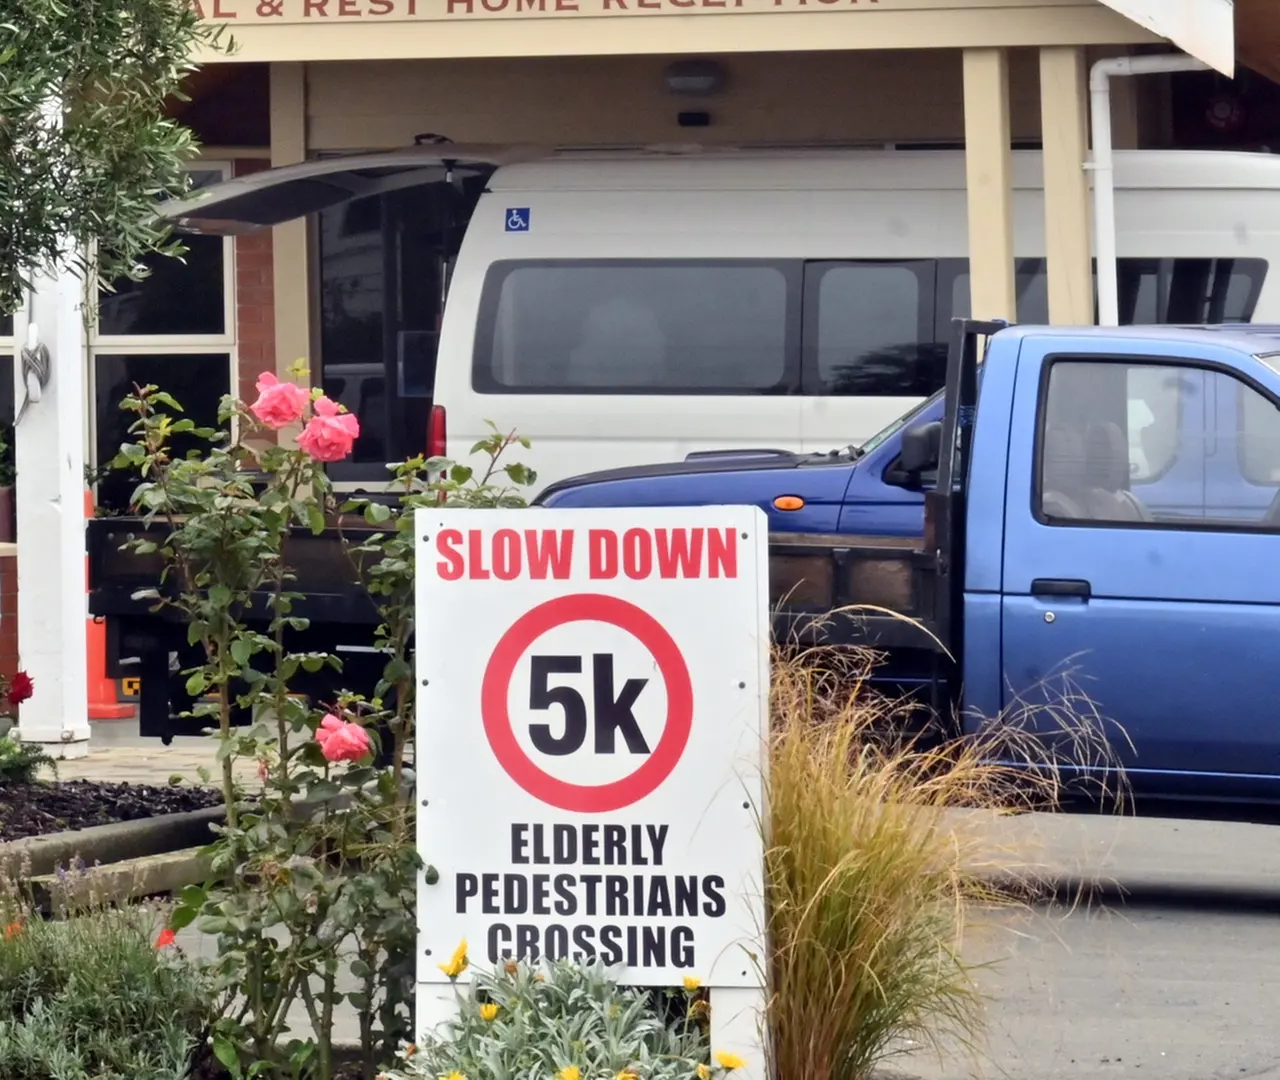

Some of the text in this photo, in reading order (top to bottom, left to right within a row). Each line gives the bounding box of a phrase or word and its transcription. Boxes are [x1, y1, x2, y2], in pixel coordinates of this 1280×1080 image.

[436, 527, 738, 582] SLOW DOWN
[527, 653, 651, 757] 5k
[510, 823, 669, 866] ELDERLY
[455, 873, 727, 918] PEDESTRIANS
[487, 922, 696, 969] CROSSING
